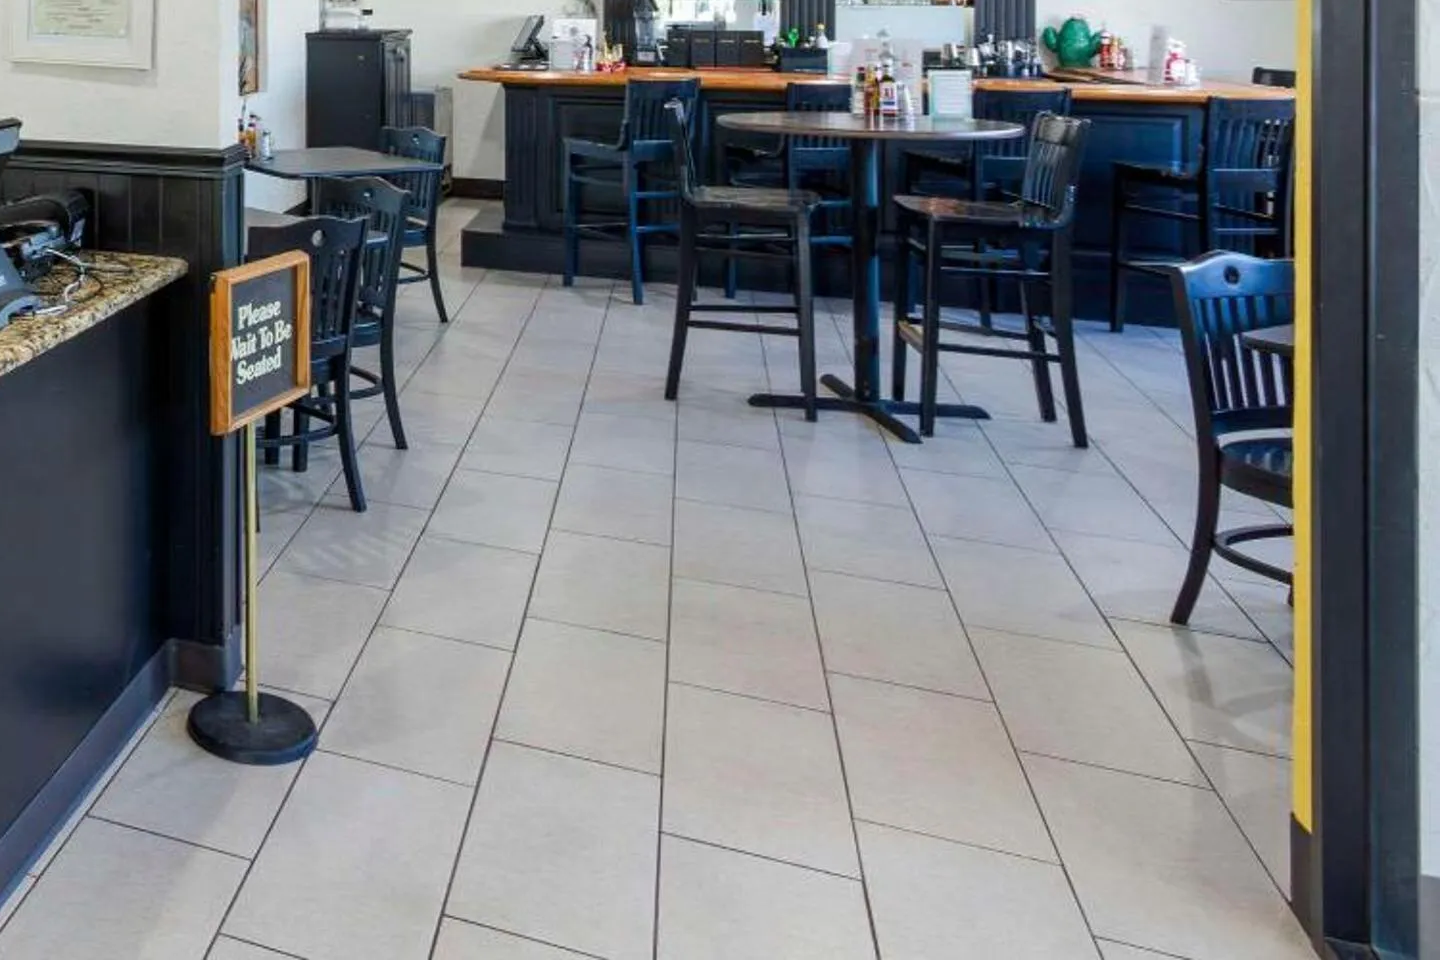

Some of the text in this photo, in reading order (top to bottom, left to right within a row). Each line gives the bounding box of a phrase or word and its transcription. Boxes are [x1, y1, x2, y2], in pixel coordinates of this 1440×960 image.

[237, 300, 281, 331] Please
[259, 326, 274, 349] To
[274, 319, 293, 344] Be
[236, 345, 282, 385] Seated
